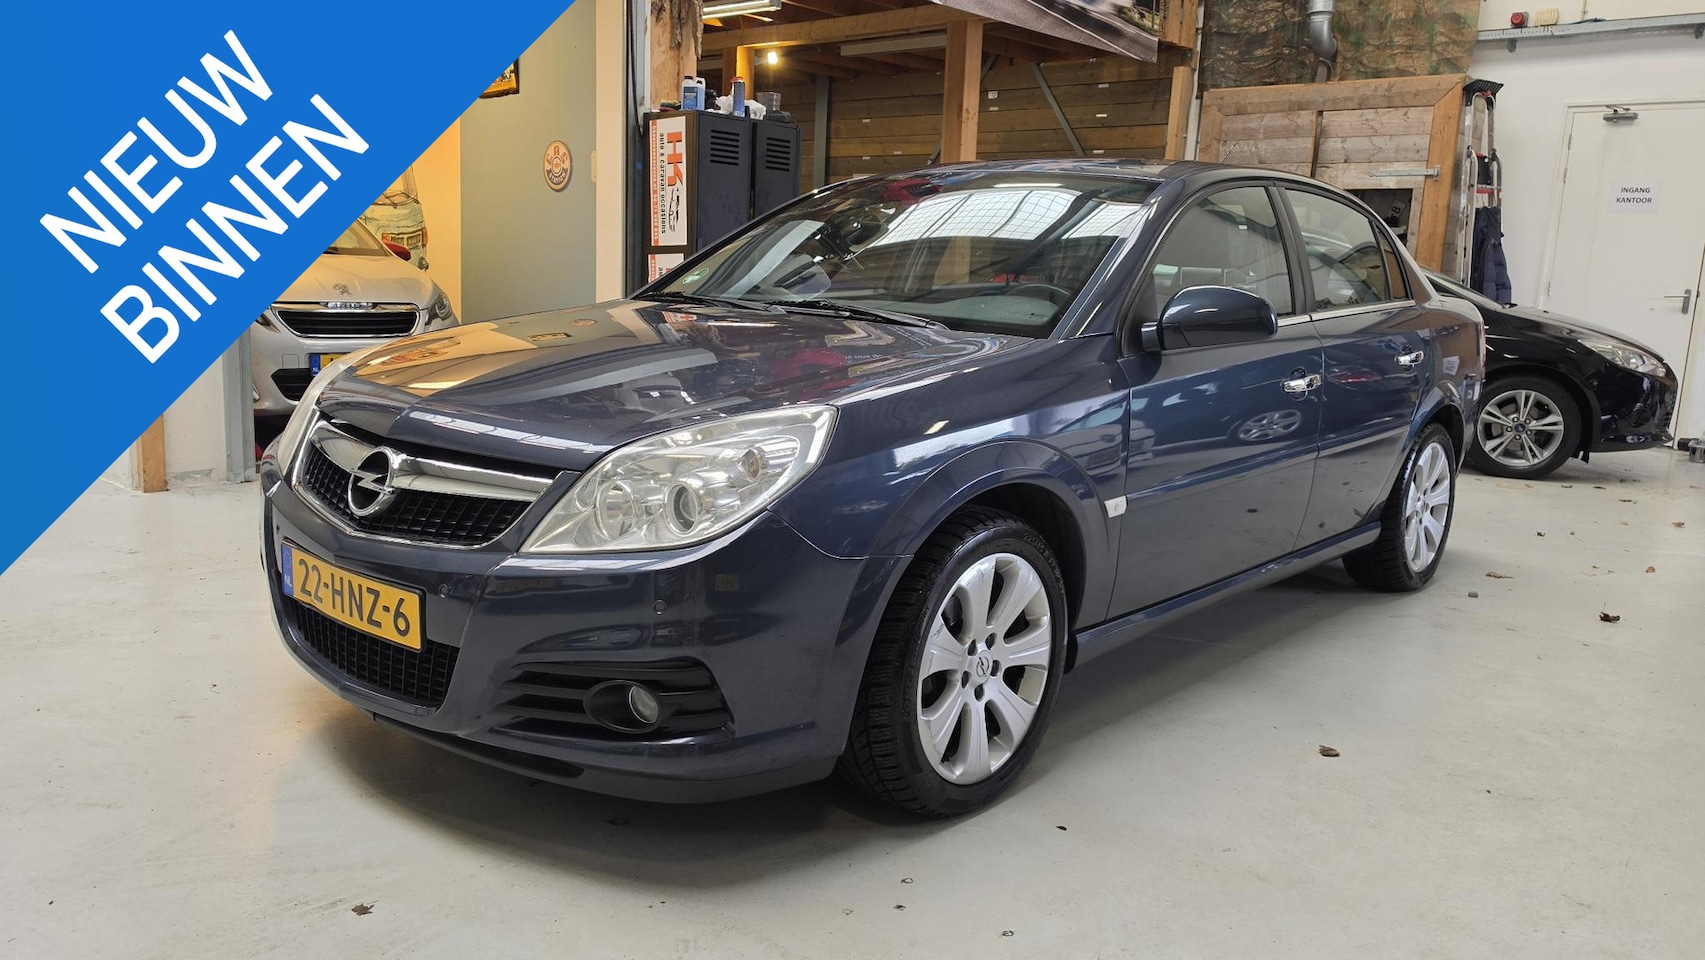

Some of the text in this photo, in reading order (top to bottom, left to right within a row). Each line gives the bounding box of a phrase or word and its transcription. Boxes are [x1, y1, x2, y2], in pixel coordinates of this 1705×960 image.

[667, 131, 683, 187] HK
[284, 574, 292, 587] NL
[298, 558, 411, 637] 22-HNZ-6
